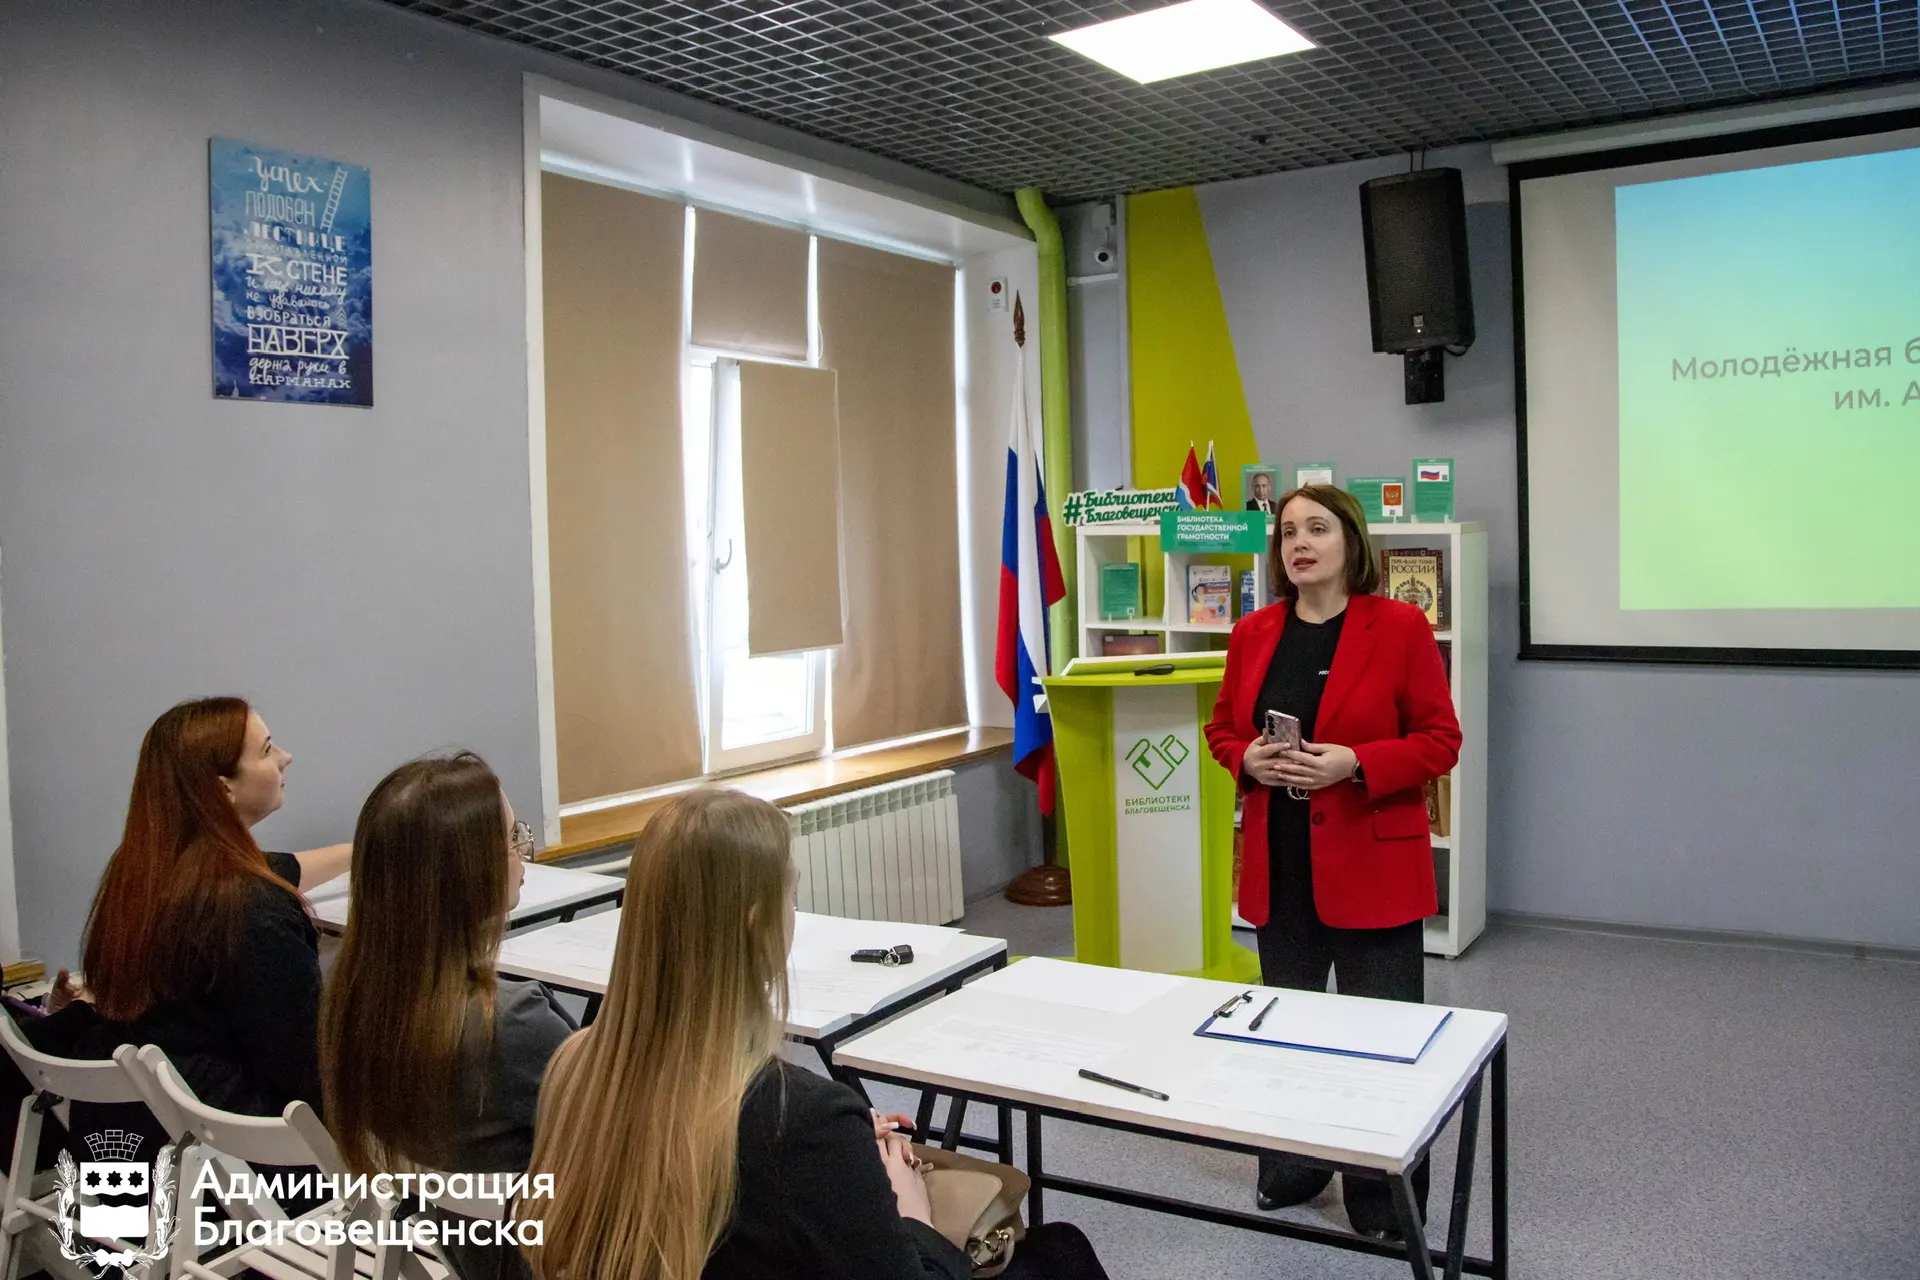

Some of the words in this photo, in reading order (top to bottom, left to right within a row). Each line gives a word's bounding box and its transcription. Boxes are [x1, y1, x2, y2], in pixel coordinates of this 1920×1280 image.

[245, 253, 282, 276] К
[286, 259, 348, 286] СТЕНЕ
[247, 323, 350, 359] НАВЕРХ
[249, 358, 292, 379] держа
[296, 360, 330, 377] руки
[1672, 346, 1892, 381] Молодёжная
[250, 373, 352, 389] КАРМАНАХ
[1834, 387, 1891, 410] им.
[1177, 515, 1224, 523] БИБЛИОТЕКА
[1177, 523, 1248, 531] ГОСУДАРСТВЕННОЙ
[1391, 565, 1435, 573] РОССИИ
[1125, 795, 1190, 806] БИБЛИОТЕКИ
